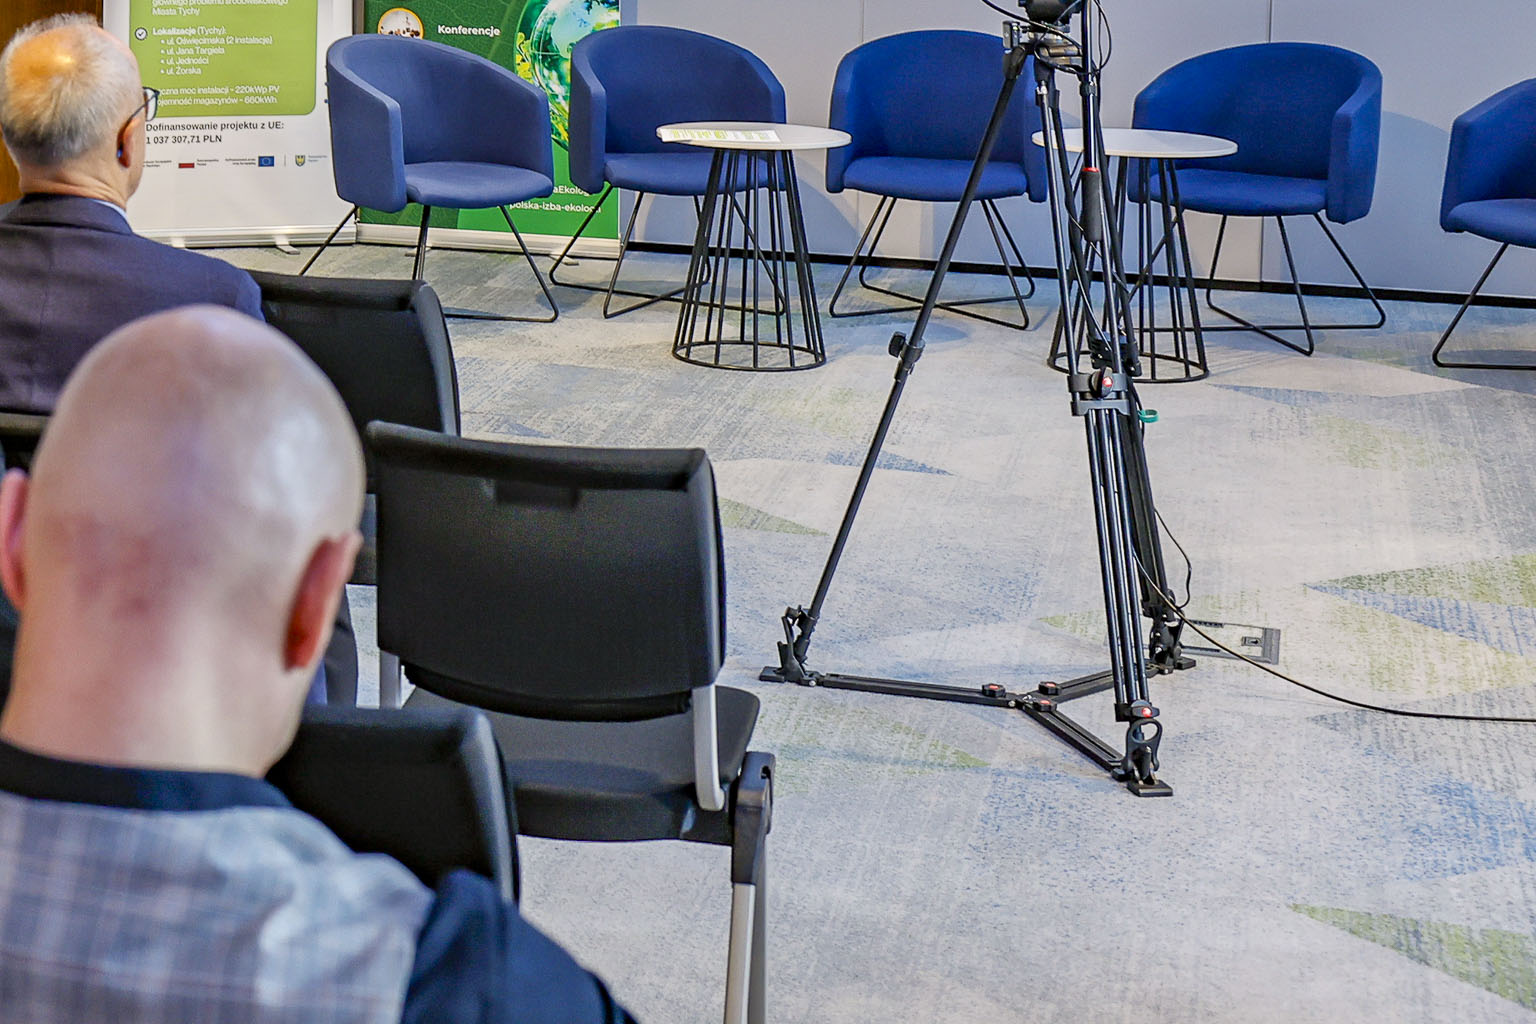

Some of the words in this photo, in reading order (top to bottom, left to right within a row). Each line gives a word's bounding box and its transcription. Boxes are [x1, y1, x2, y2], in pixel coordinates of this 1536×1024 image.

[438, 25, 500, 36] Konferencje
[146, 122, 218, 131] Dofinansowanie
[221, 121, 257, 131] projektu
[154, 136, 169, 144] 037
[172, 136, 200, 144] 307,71
[203, 135, 222, 143] PLN
